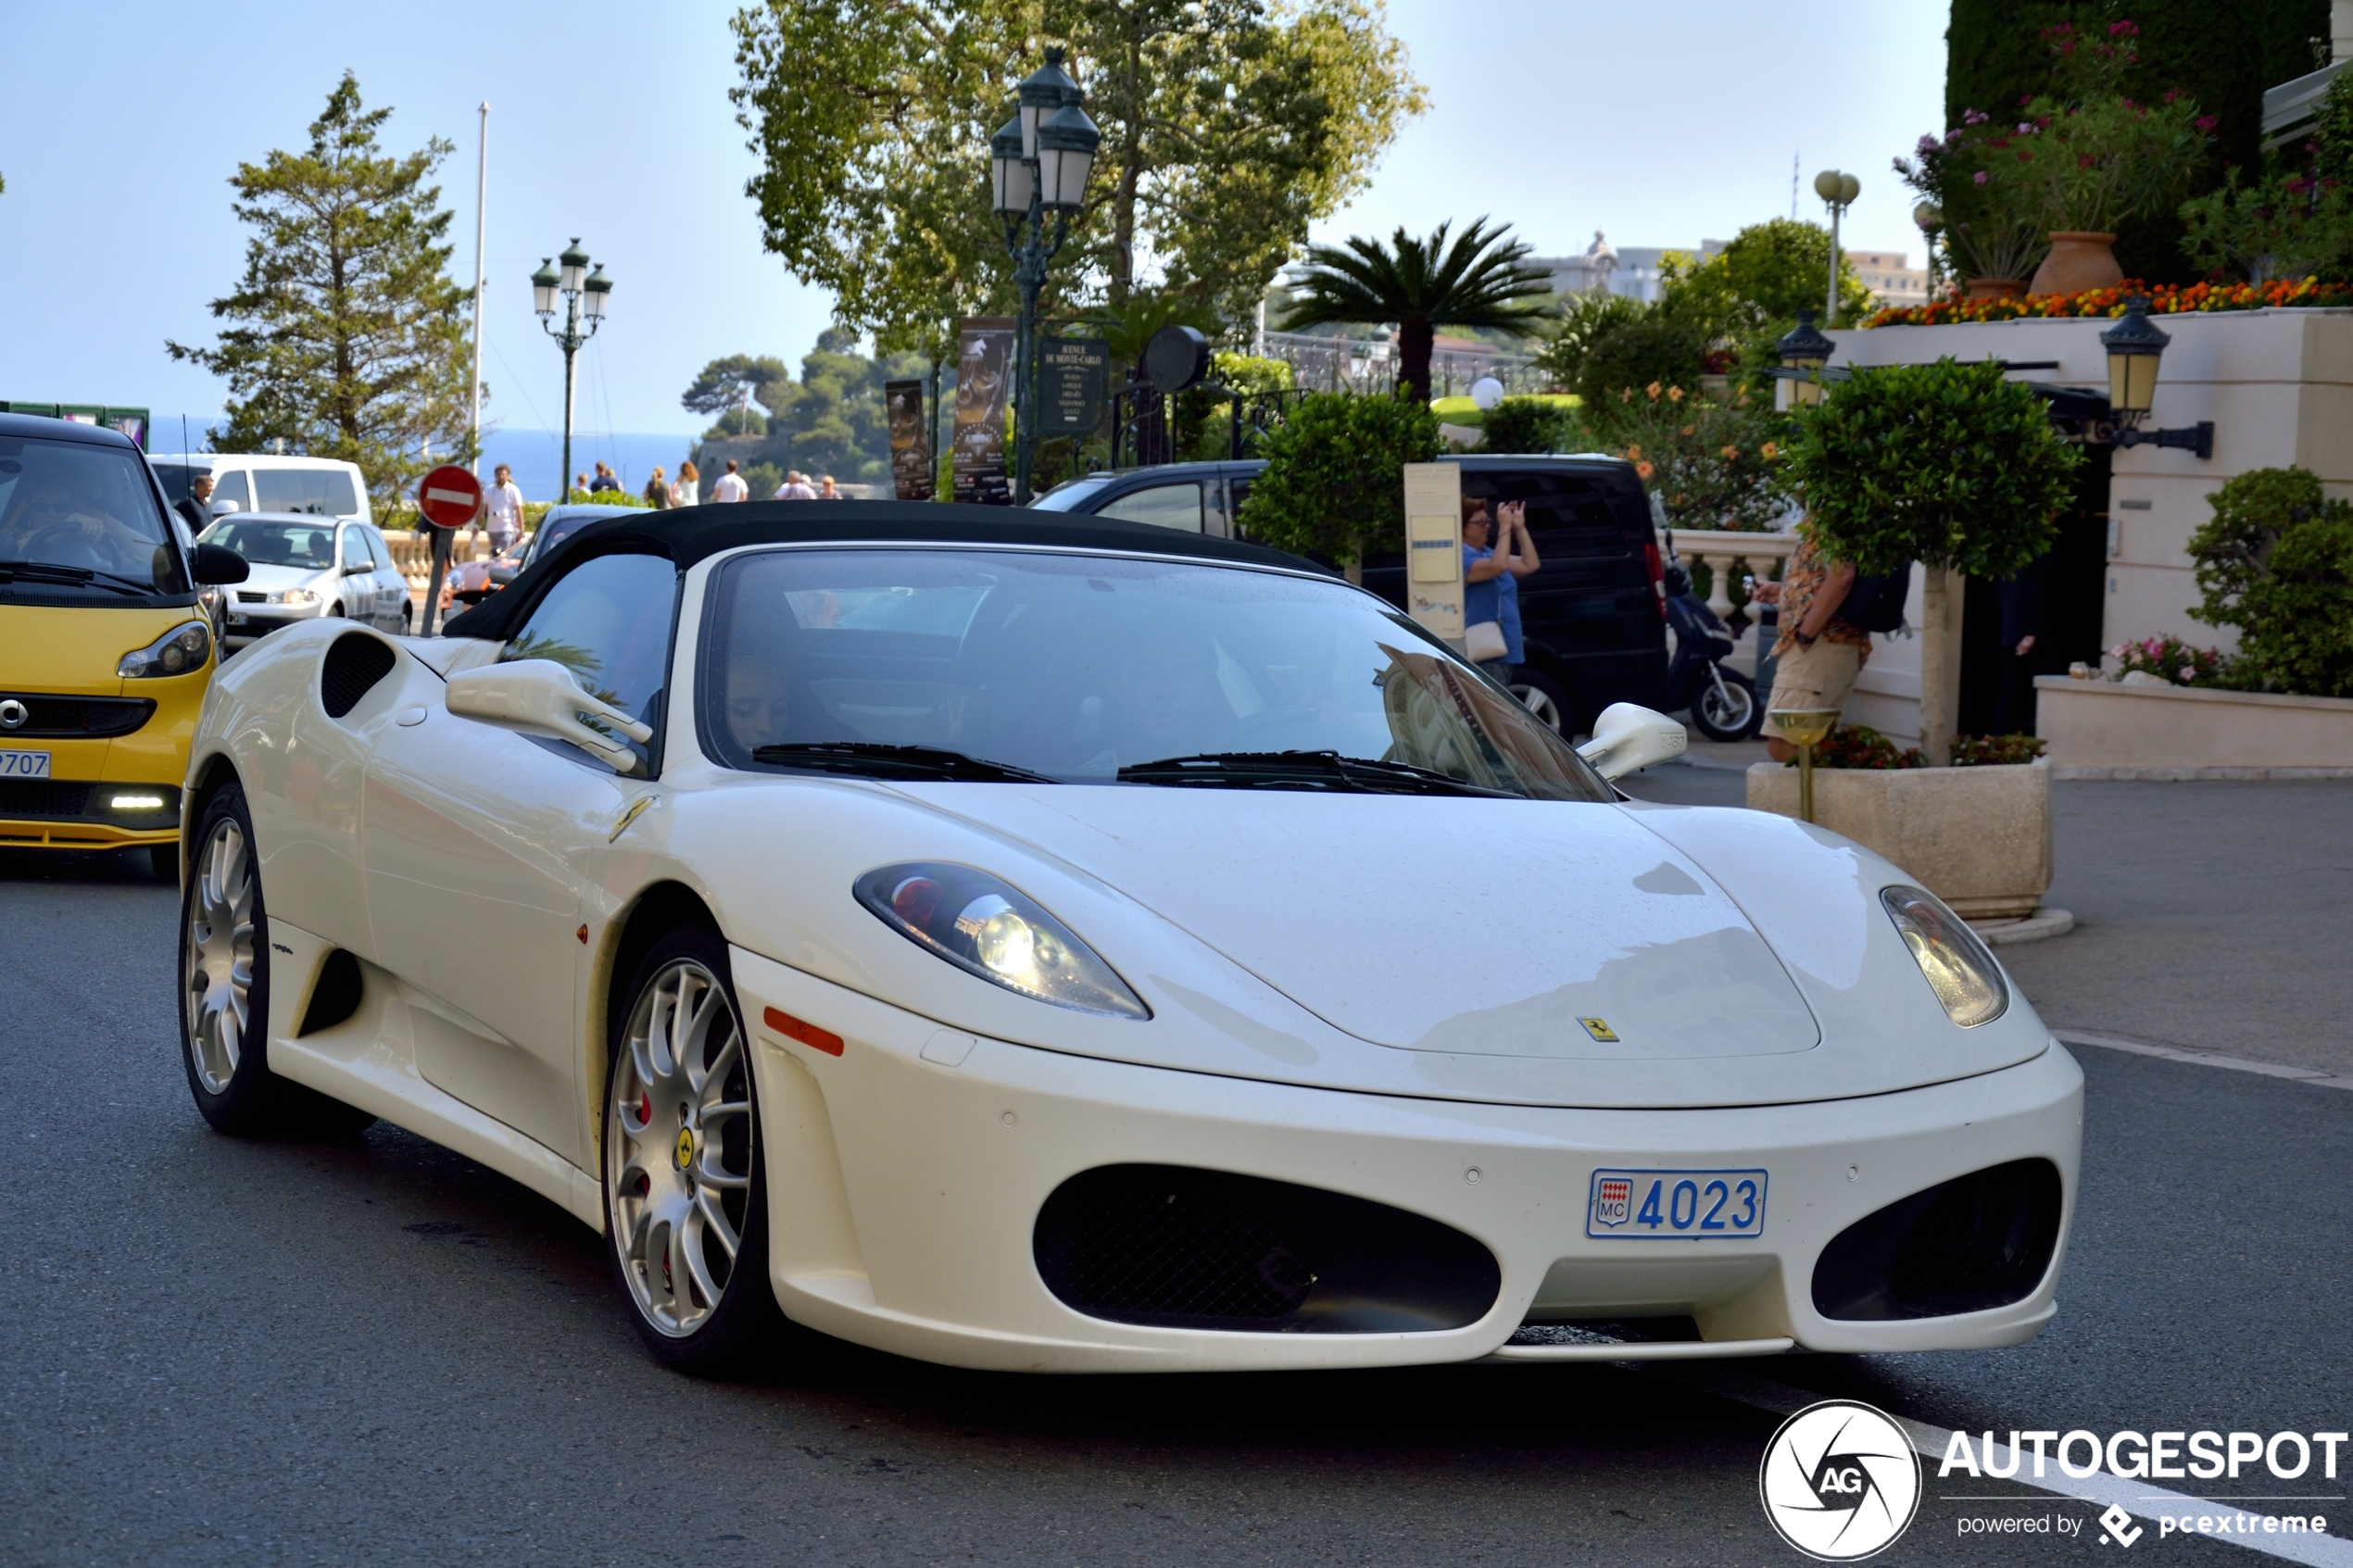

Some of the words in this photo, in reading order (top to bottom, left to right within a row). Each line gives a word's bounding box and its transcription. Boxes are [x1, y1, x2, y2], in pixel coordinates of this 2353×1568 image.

[1061, 345, 1087, 355] AVENUE
[1045, 354, 1055, 363] DE
[1056, 354, 1101, 365] MONTE-CARLO
[1600, 1203, 1625, 1217] MC
[1637, 1179, 1757, 1230] 4023
